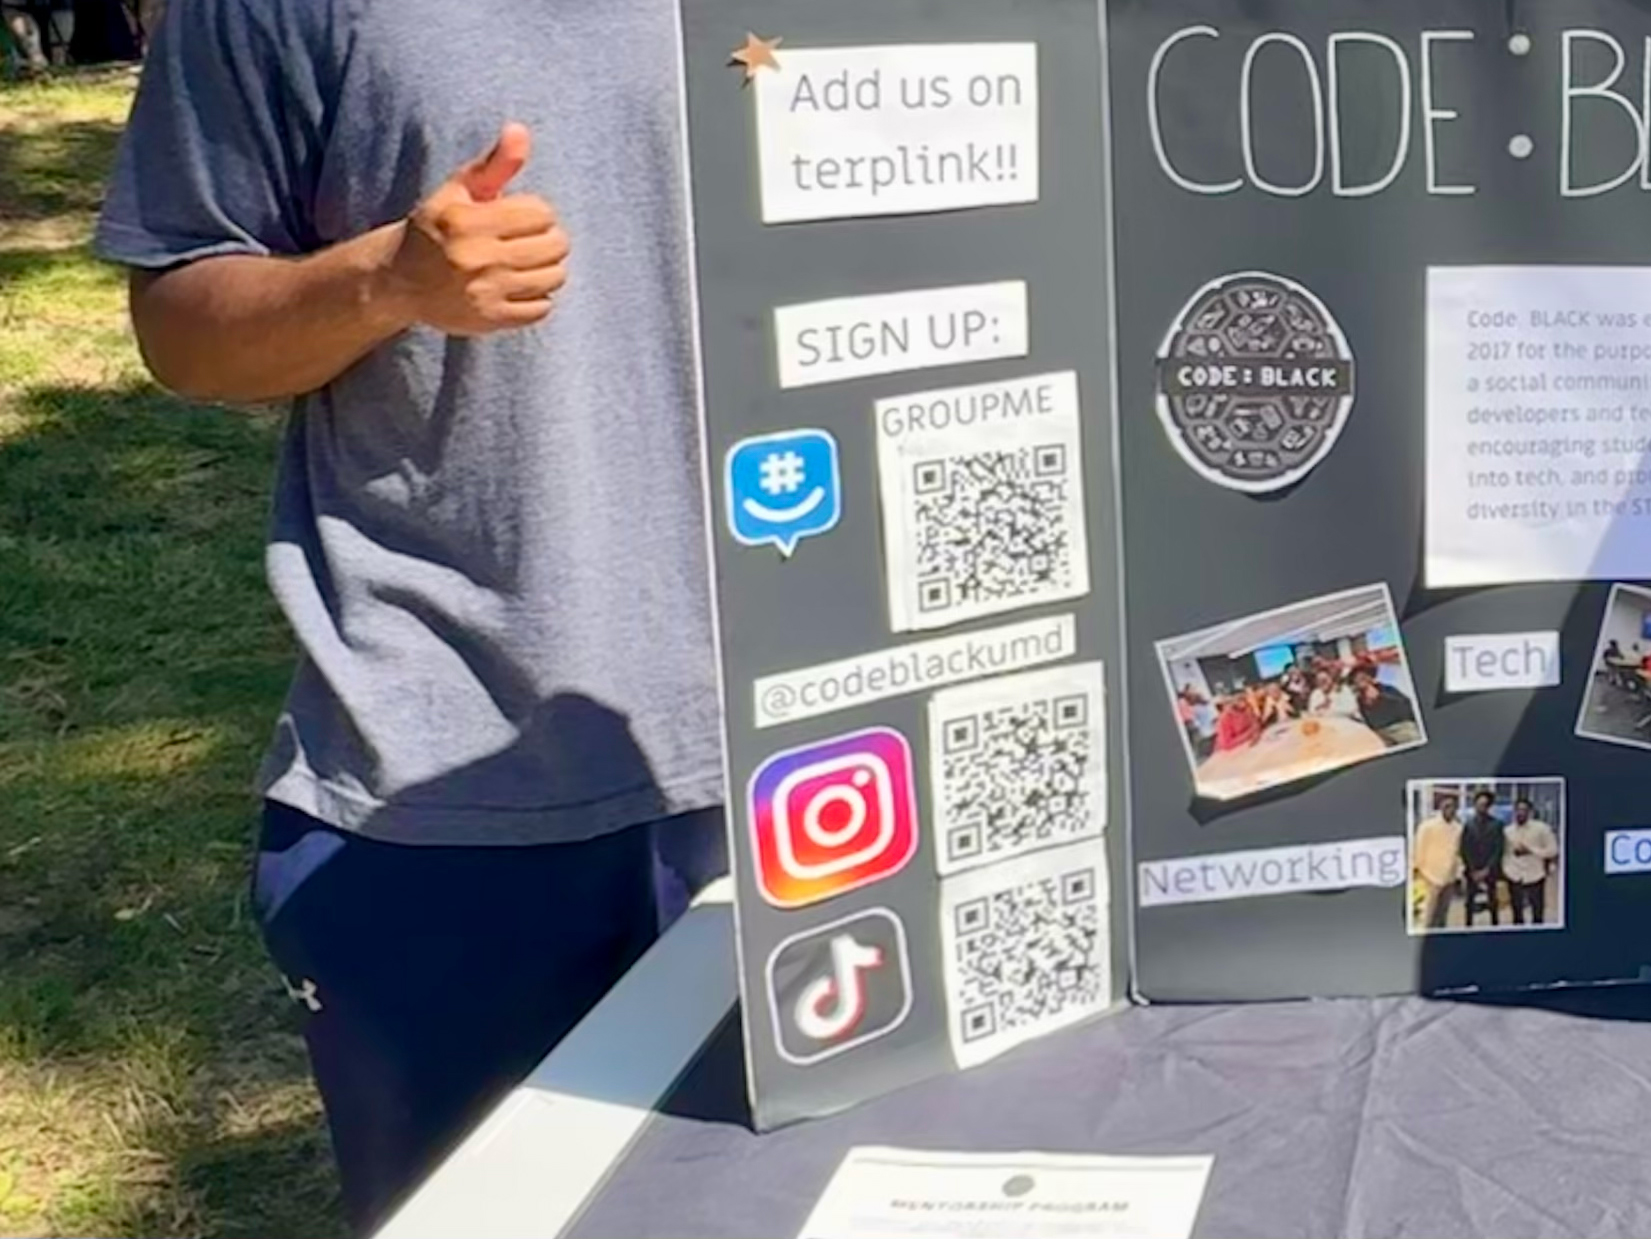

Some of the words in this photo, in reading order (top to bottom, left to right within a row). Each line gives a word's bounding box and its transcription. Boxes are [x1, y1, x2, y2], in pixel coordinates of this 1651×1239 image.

[789, 68, 880, 112] Add
[900, 76, 951, 109] us
[968, 73, 1021, 107] on
[1147, 24, 1475, 196] CODE
[791, 142, 1018, 196] terplink!!
[1530, 310, 1591, 328] BLACK
[1596, 313, 1638, 329] was
[795, 317, 910, 367] SIGN
[927, 309, 1001, 350] UP:
[1466, 341, 1511, 361] 2017
[1516, 341, 1547, 359] for
[1553, 341, 1589, 359] the
[1177, 365, 1238, 387] CODE
[1260, 366, 1337, 387] BLACK
[1466, 377, 1480, 393] a
[1485, 373, 1548, 392] social
[881, 384, 1054, 438] GROUPME
[1466, 404, 1581, 426] developers
[1585, 404, 1624, 423] and
[1466, 436, 1596, 459] encouraging
[1467, 469, 1511, 488] into
[1570, 468, 1609, 487] and
[1466, 500, 1560, 520] diversity
[1566, 500, 1588, 517] in
[1592, 498, 1628, 517] the
[1451, 639, 1546, 679] Tech
[761, 624, 1063, 718] @codeblackumd
[1142, 847, 1401, 897] Networking
[1029, 1200, 1130, 1213] PROGRAM
